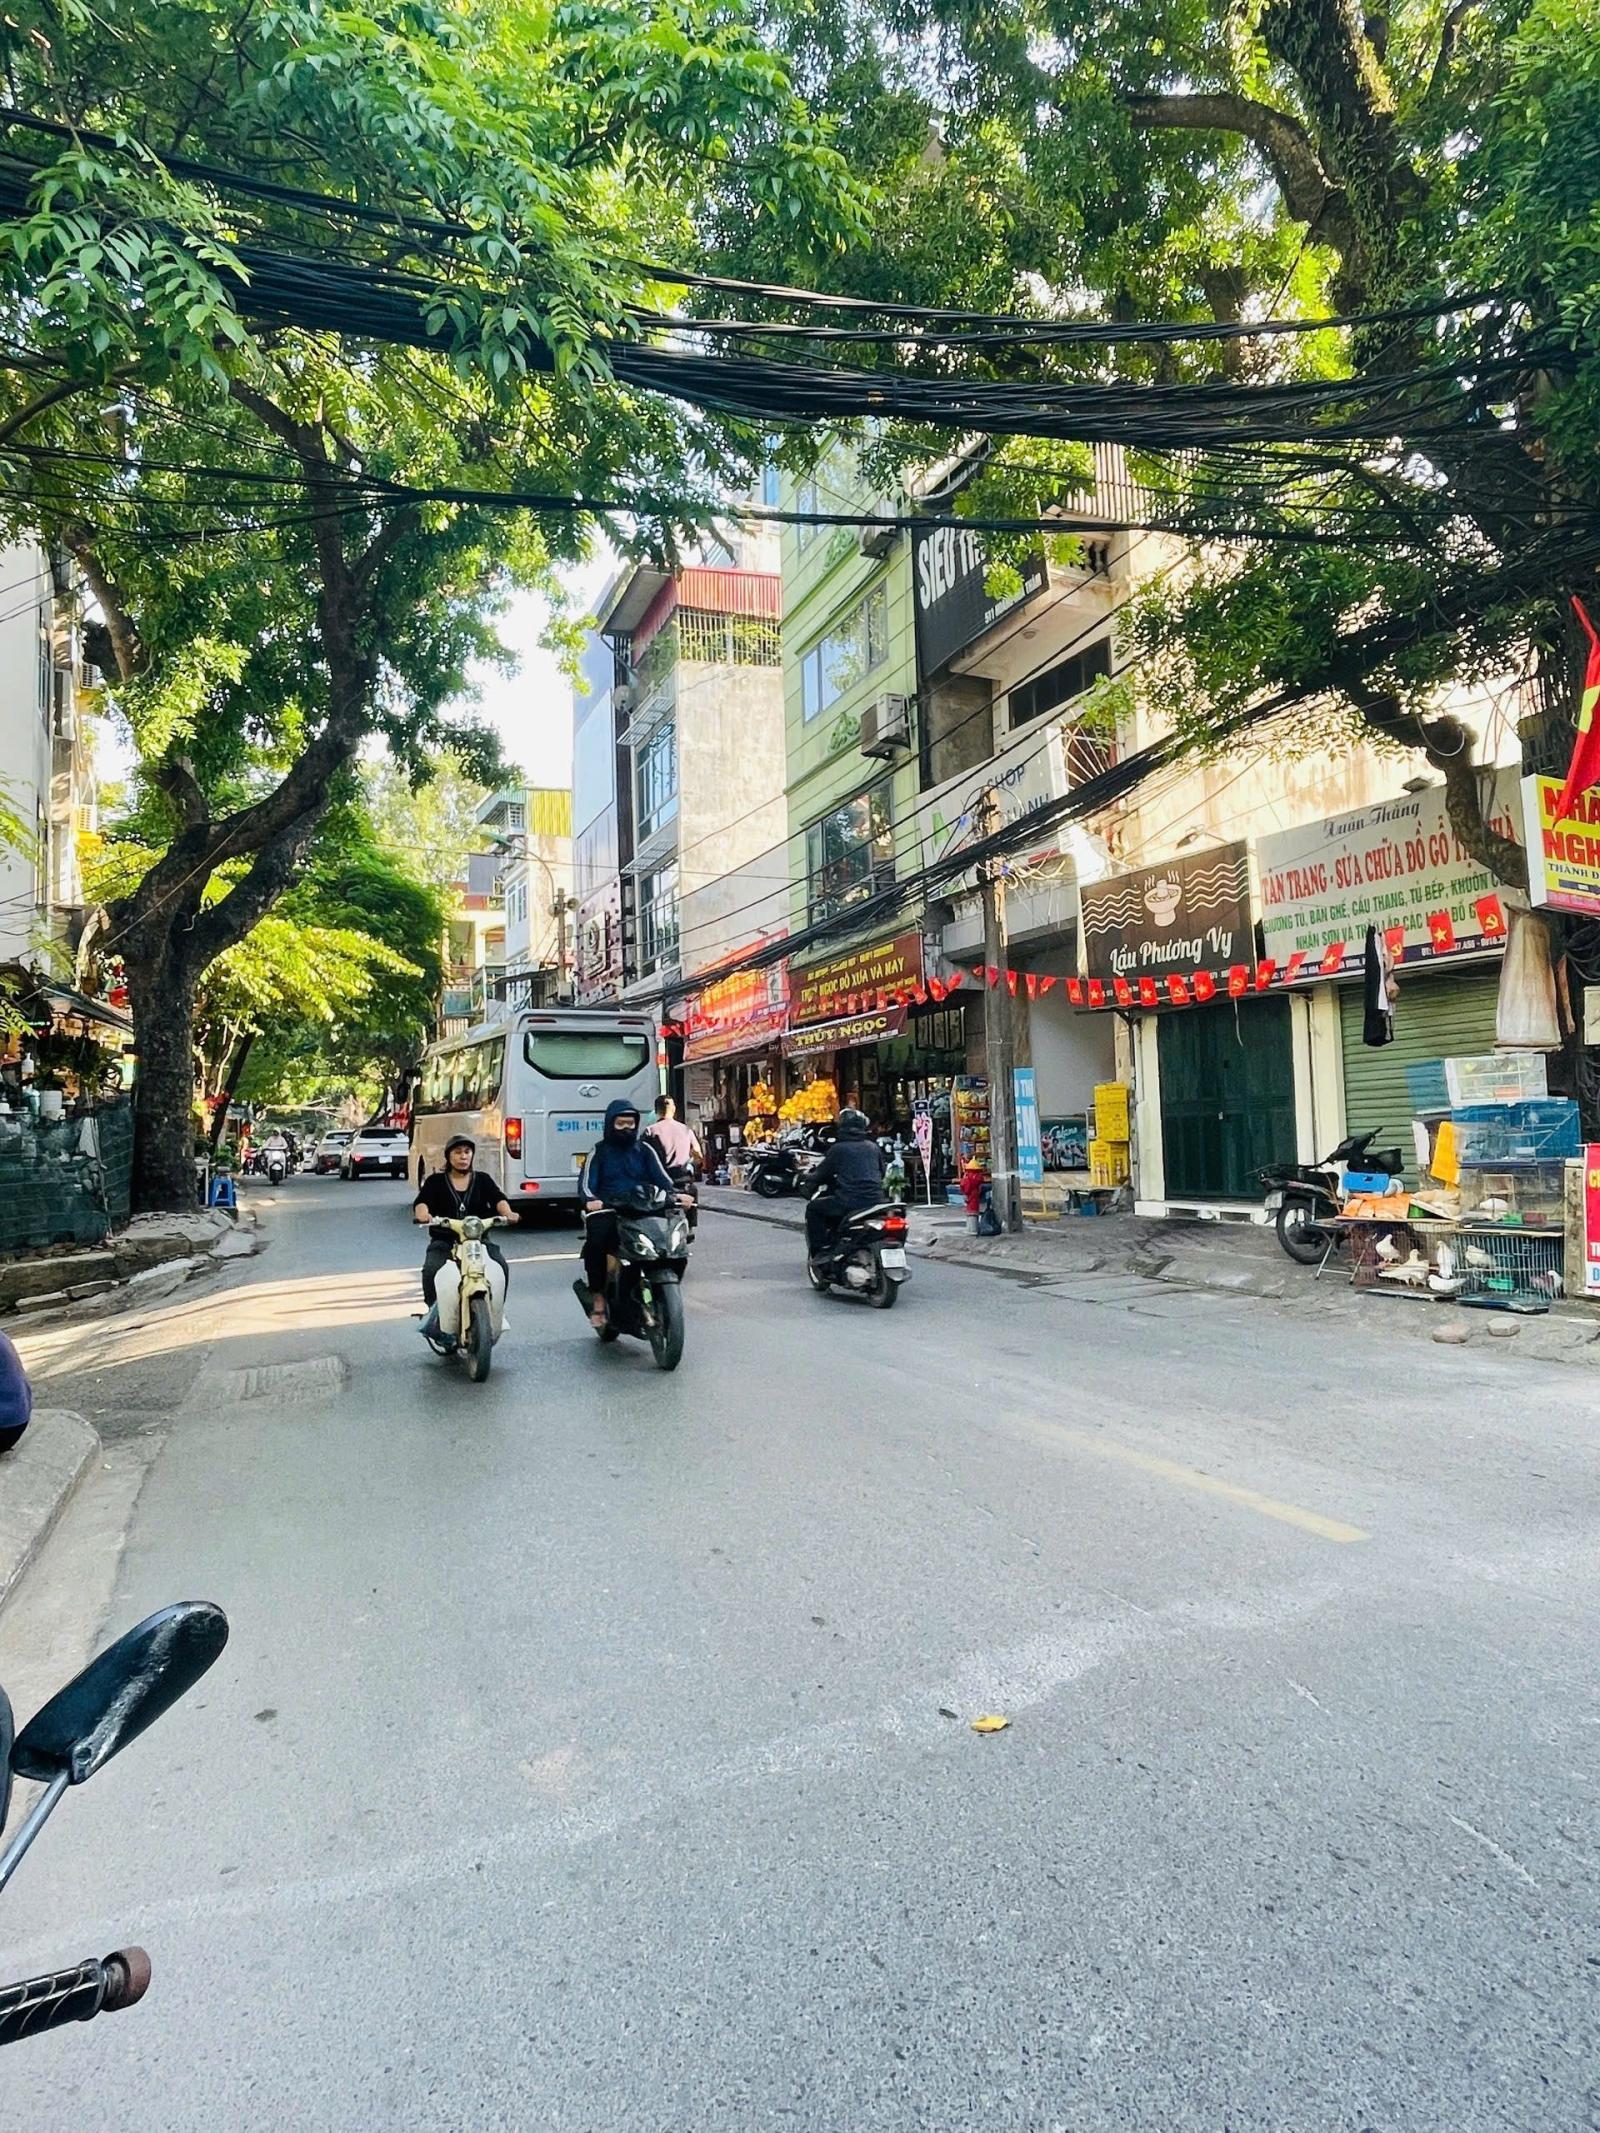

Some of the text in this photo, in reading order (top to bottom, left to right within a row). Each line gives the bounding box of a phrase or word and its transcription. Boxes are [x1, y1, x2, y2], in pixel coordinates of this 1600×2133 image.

[987, 763, 1025, 789] SHOP
[1286, 863, 1328, 900] TRANG
[1109, 926, 1233, 976] Lẩu Phương Vy
[839, 1016, 887, 1035] NGỌC
